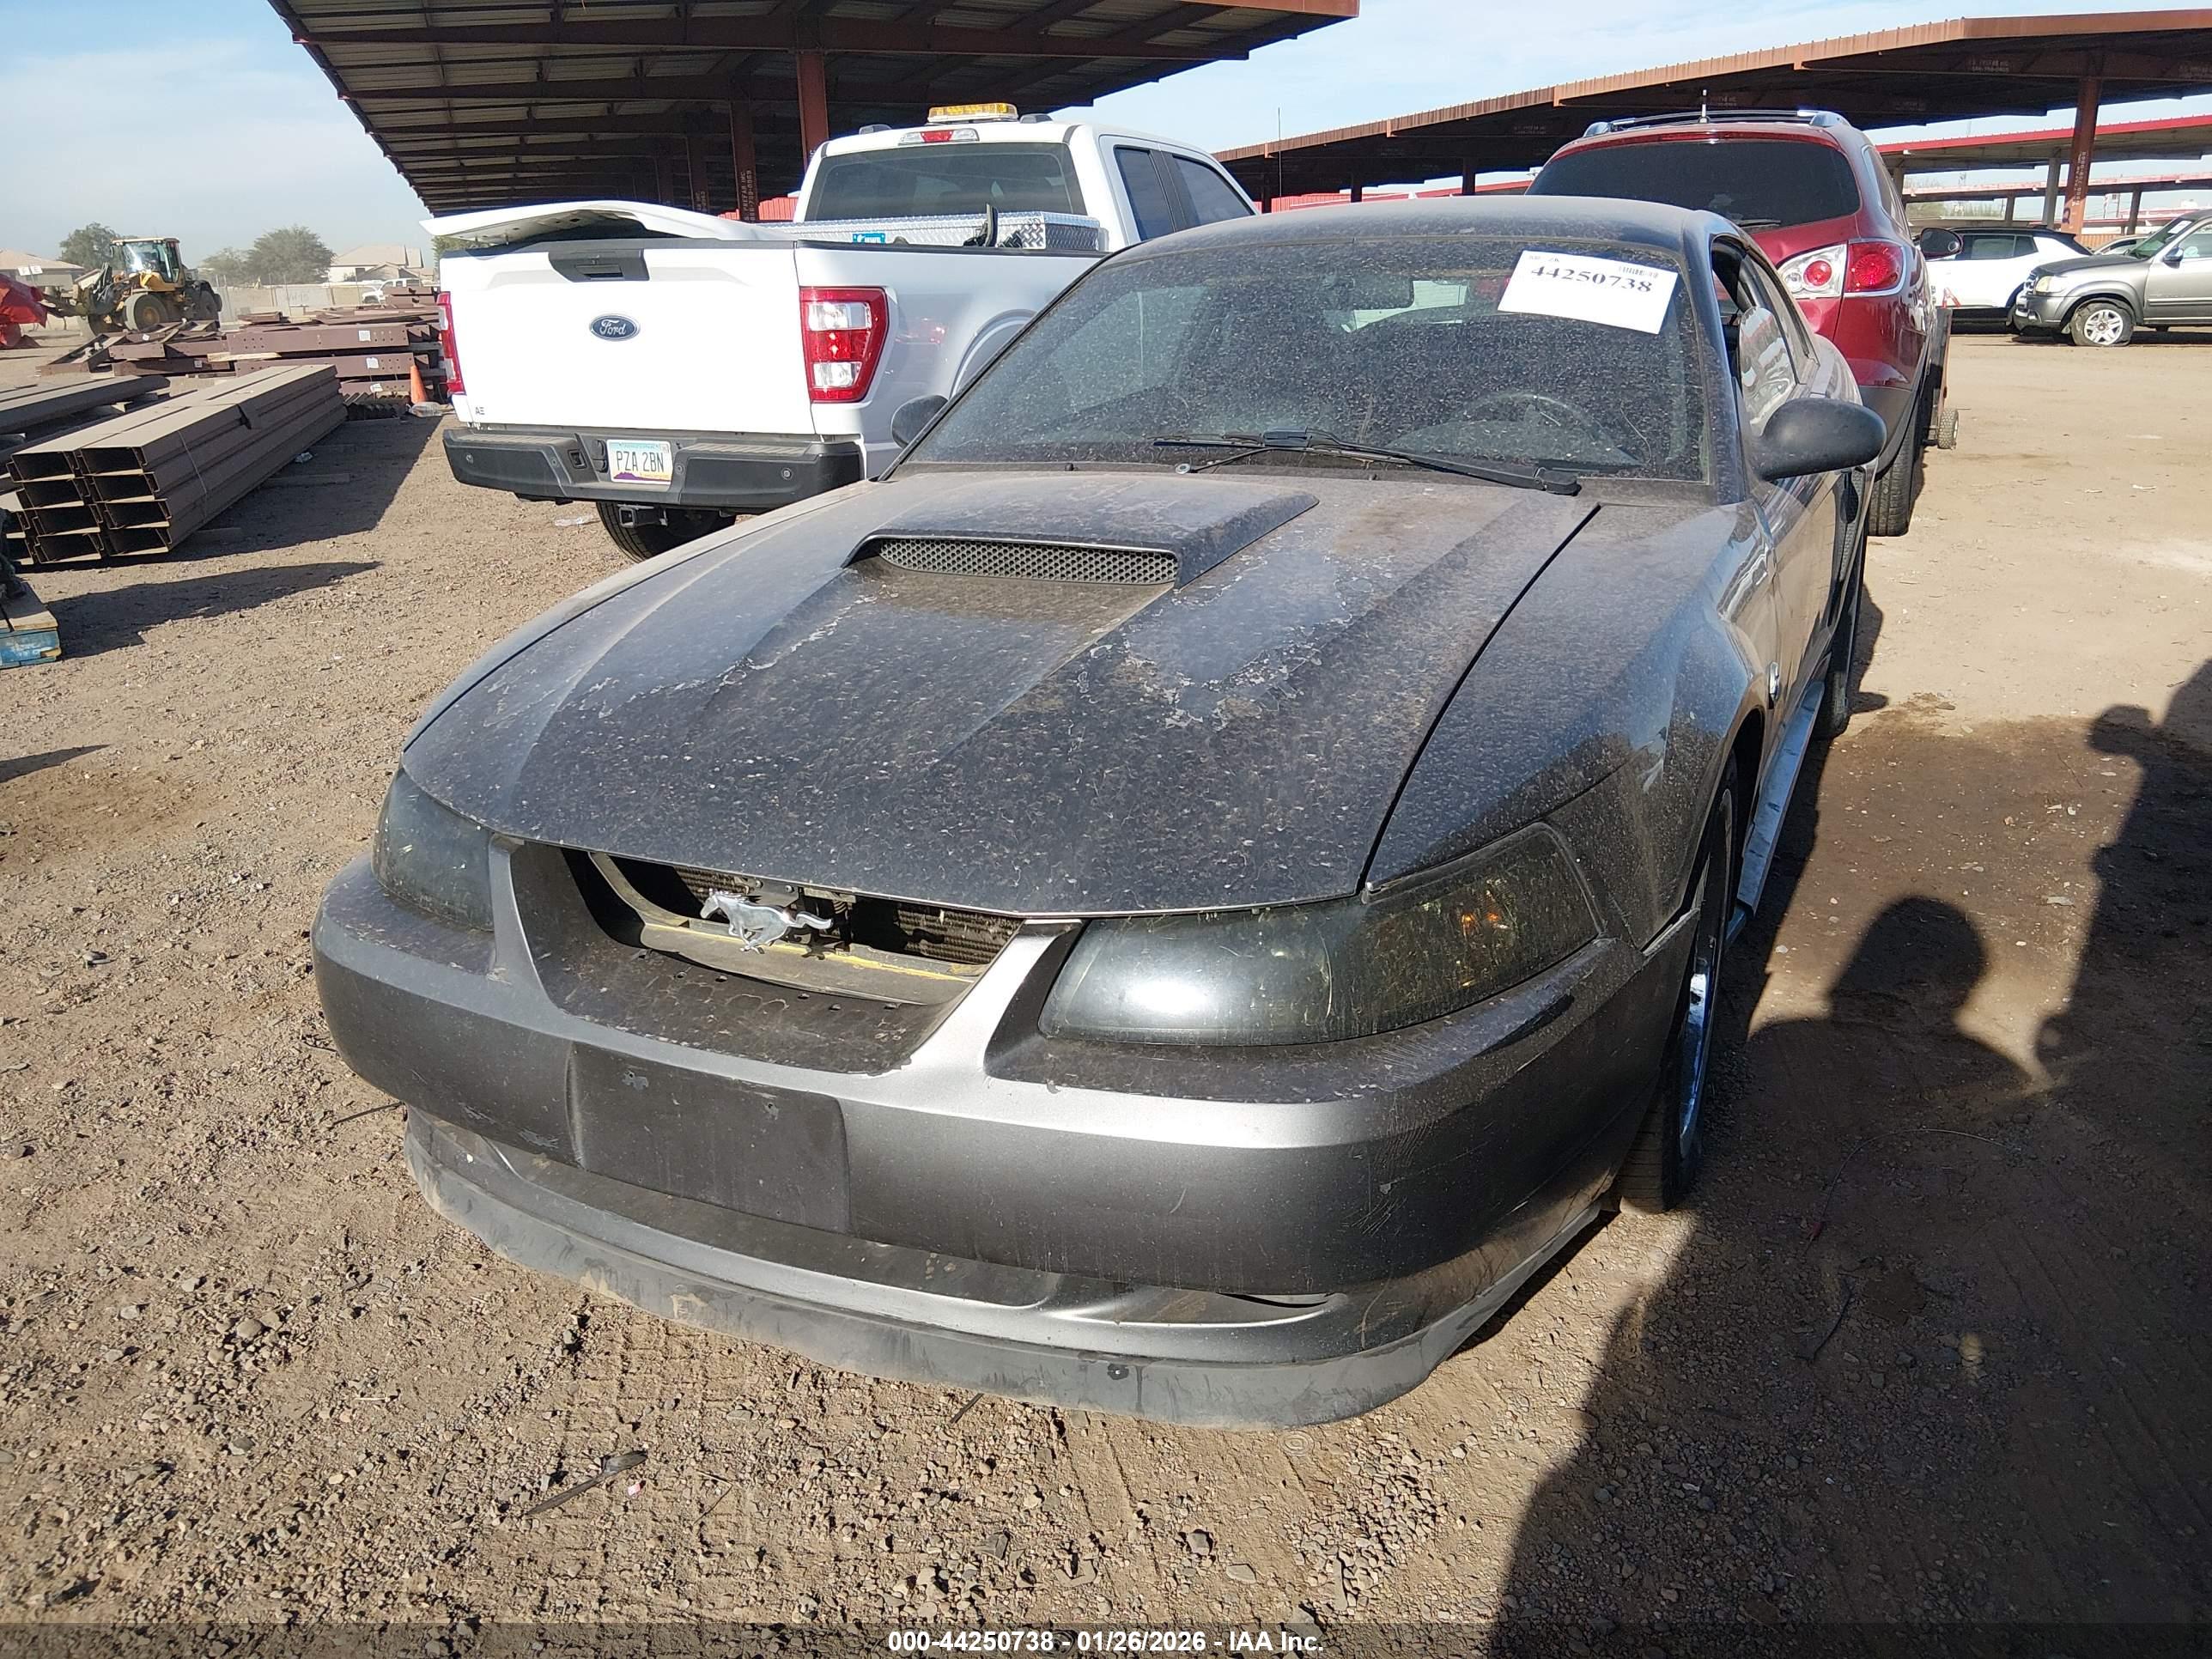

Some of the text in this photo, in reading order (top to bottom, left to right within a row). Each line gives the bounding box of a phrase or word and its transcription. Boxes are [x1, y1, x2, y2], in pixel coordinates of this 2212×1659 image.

[1531, 265, 1652, 292] 44250738
[599, 319, 627, 335] Ford
[616, 450, 665, 473] PZA 2BN
